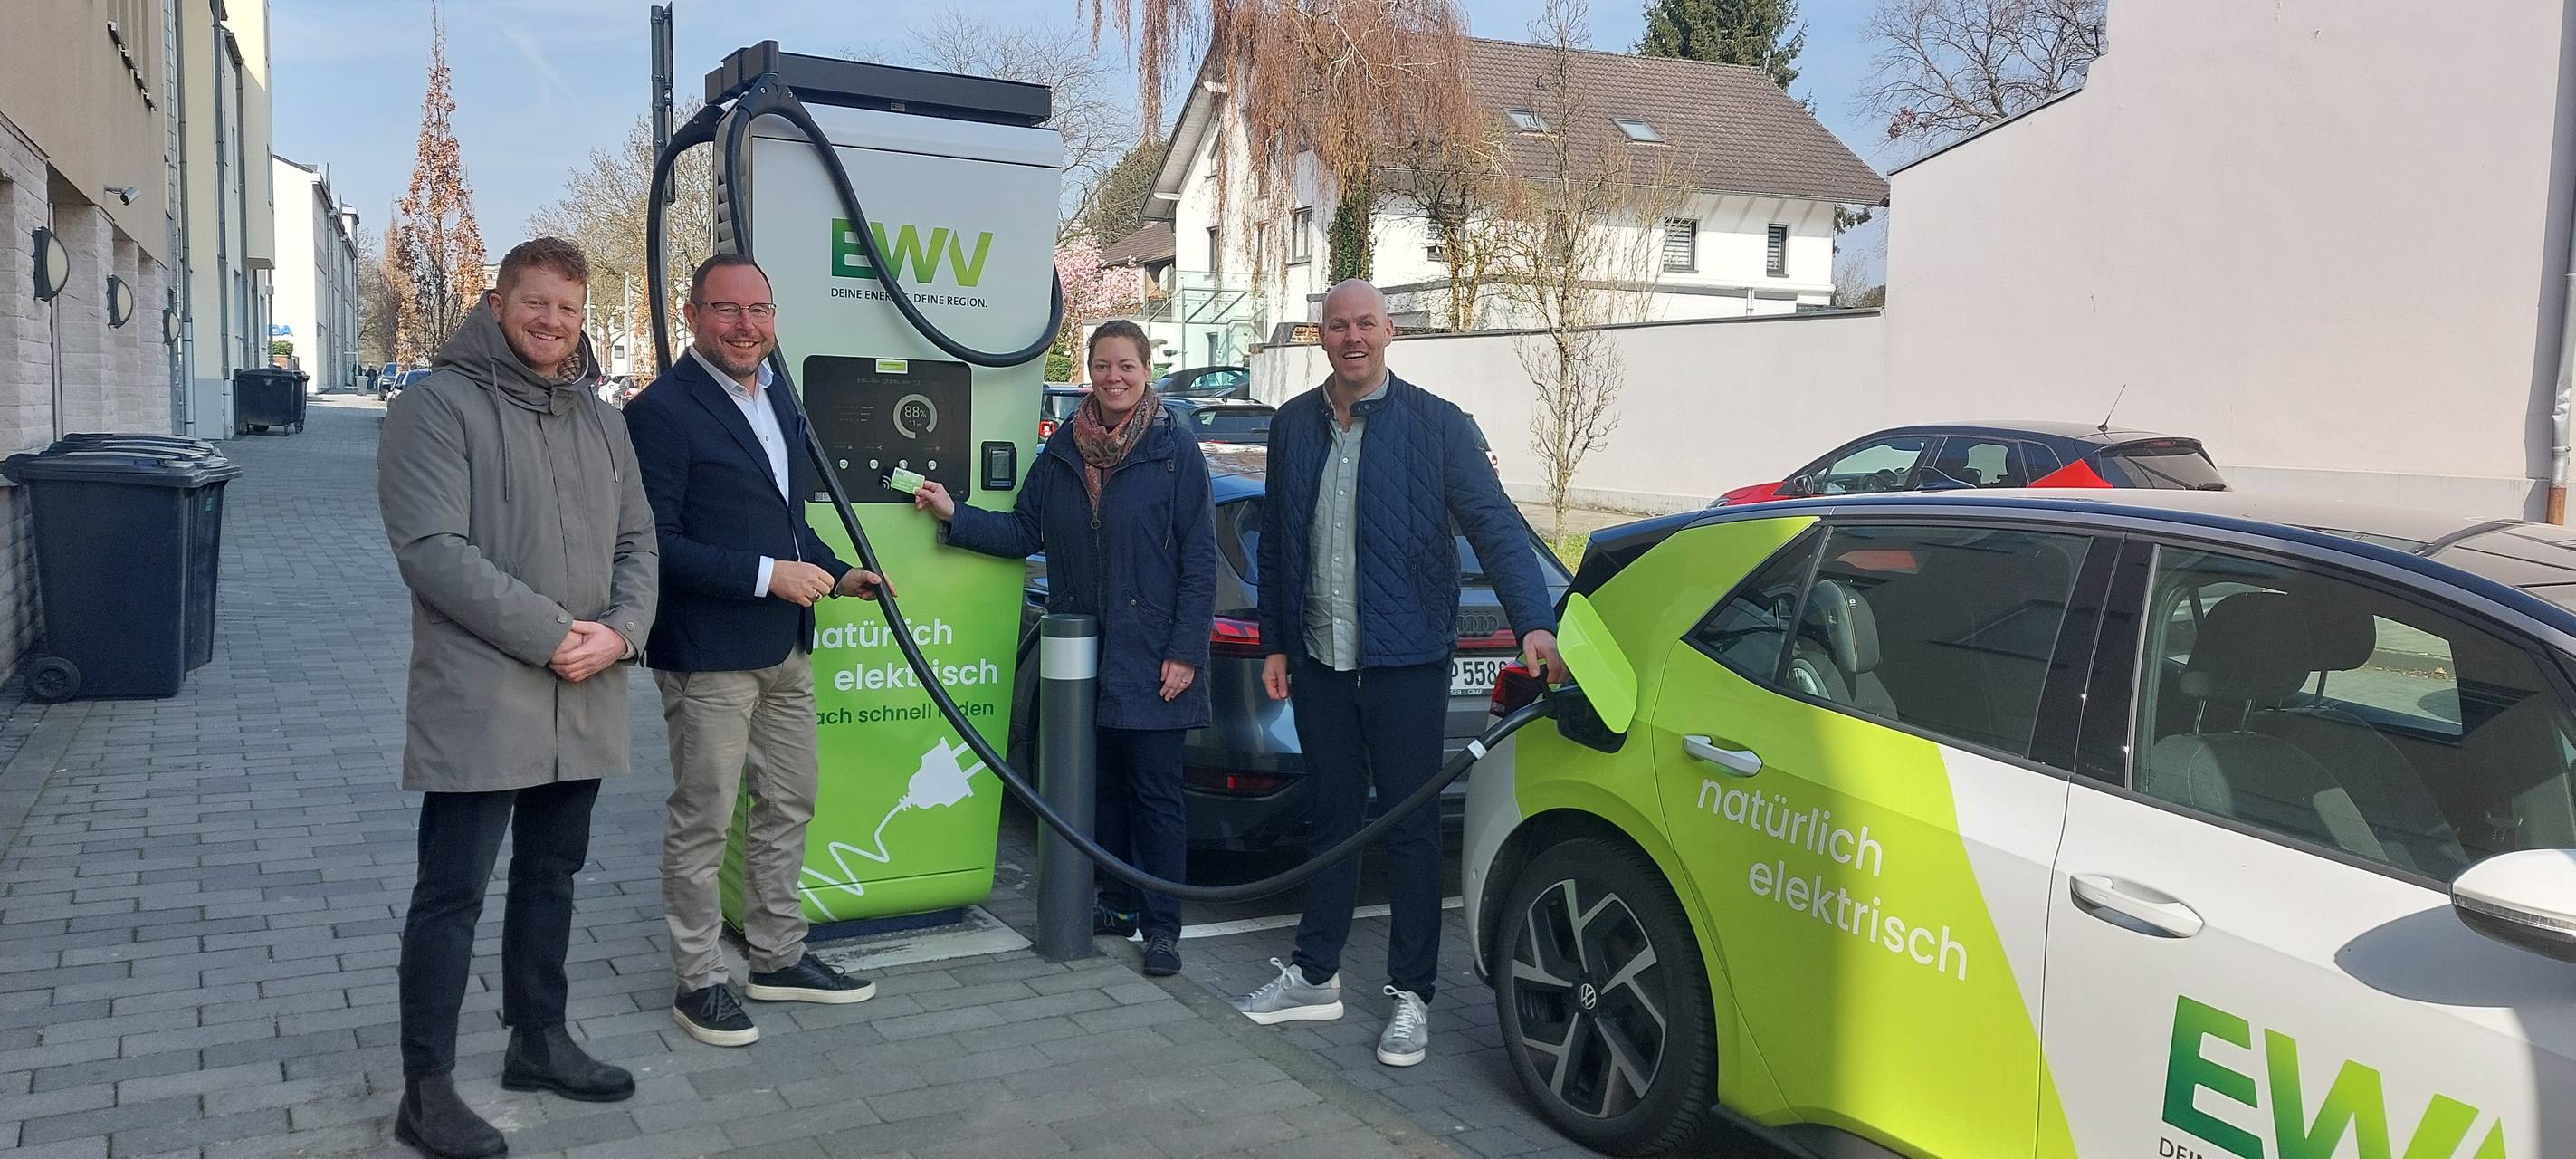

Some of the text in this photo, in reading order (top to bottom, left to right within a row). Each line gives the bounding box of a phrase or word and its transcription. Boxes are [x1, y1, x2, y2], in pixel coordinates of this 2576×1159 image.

[832, 218, 993, 287] EWV
[830, 287, 861, 300] DEINE
[913, 292, 944, 305] DEINE
[947, 295, 988, 309] REGION.
[813, 618, 952, 648] atürch
[834, 659, 997, 691] elektisch
[816, 700, 994, 725] ach schnell den
[1697, 778, 1883, 877] natürlich
[1749, 859, 1968, 981] elektrisch
